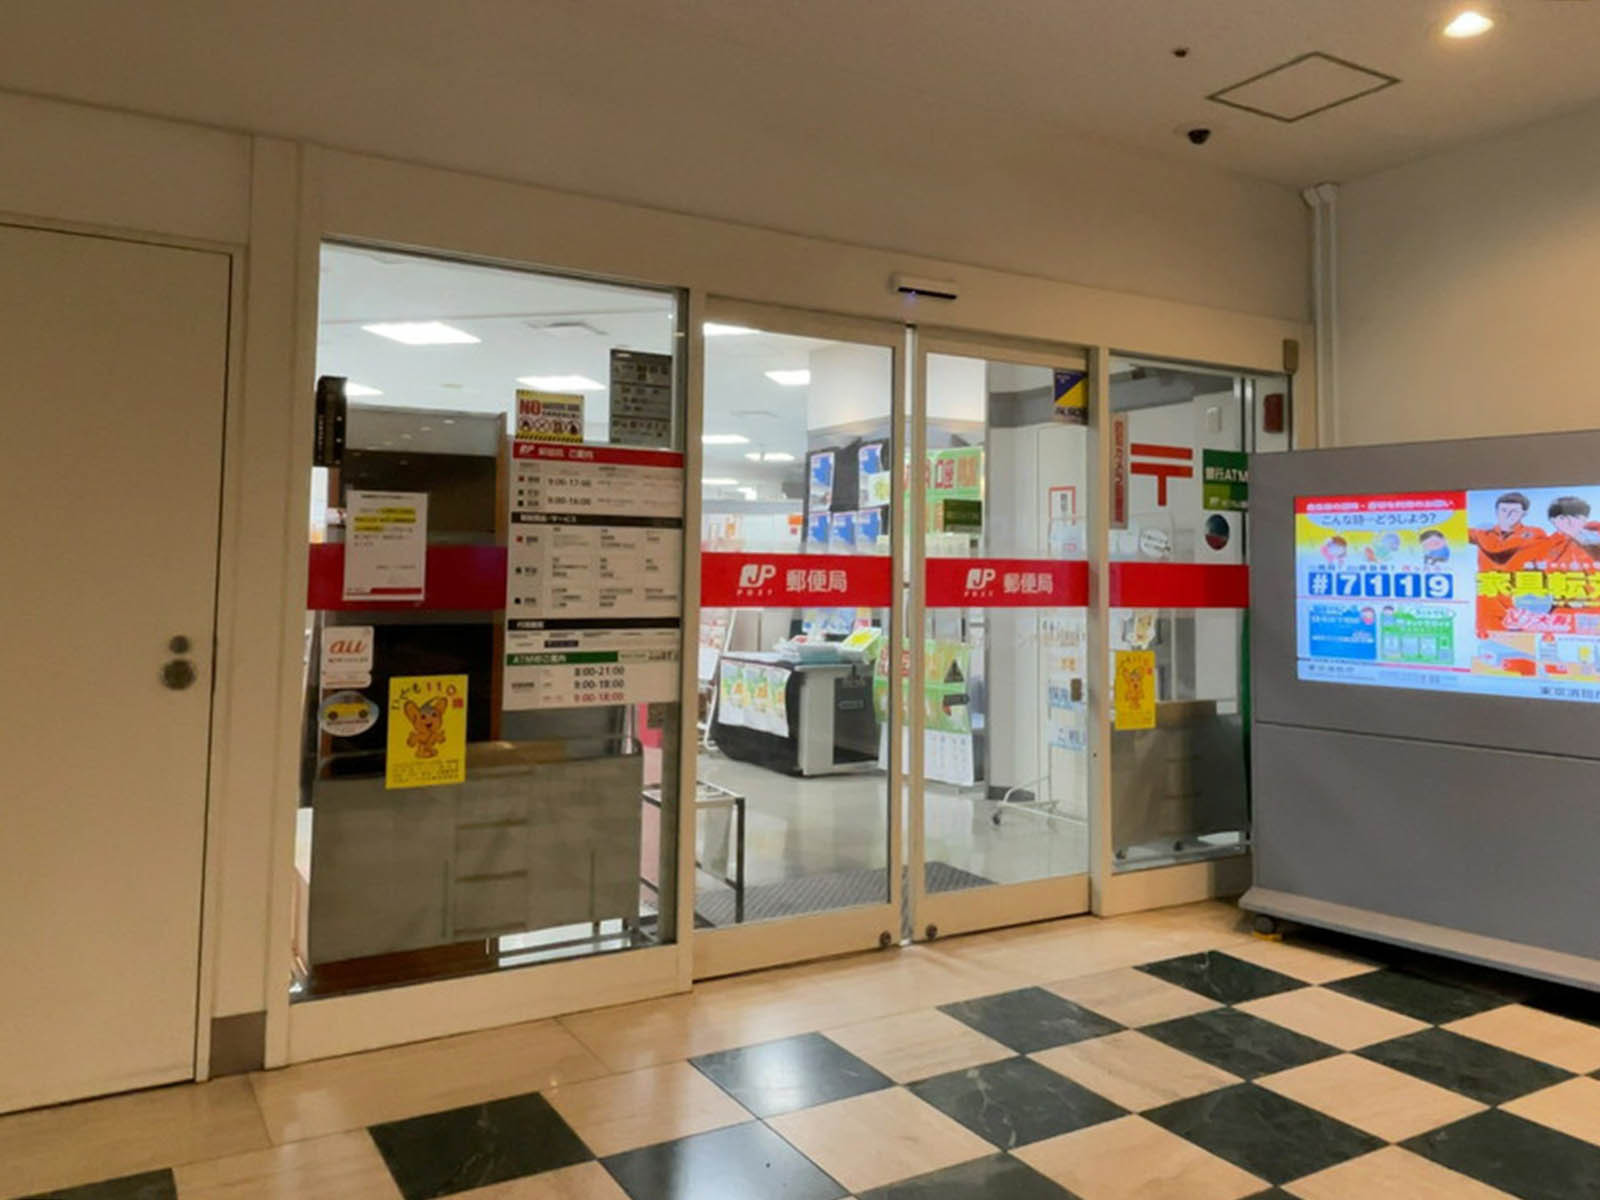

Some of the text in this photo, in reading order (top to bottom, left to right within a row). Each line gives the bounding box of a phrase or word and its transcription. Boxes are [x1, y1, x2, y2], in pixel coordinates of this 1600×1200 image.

[519, 399, 541, 416] NO
[785, 568, 848, 593] 郵便局
[1003, 572, 1053, 594] 郵便局
[1311, 574, 1450, 597] #7119
[329, 639, 365, 655] au
